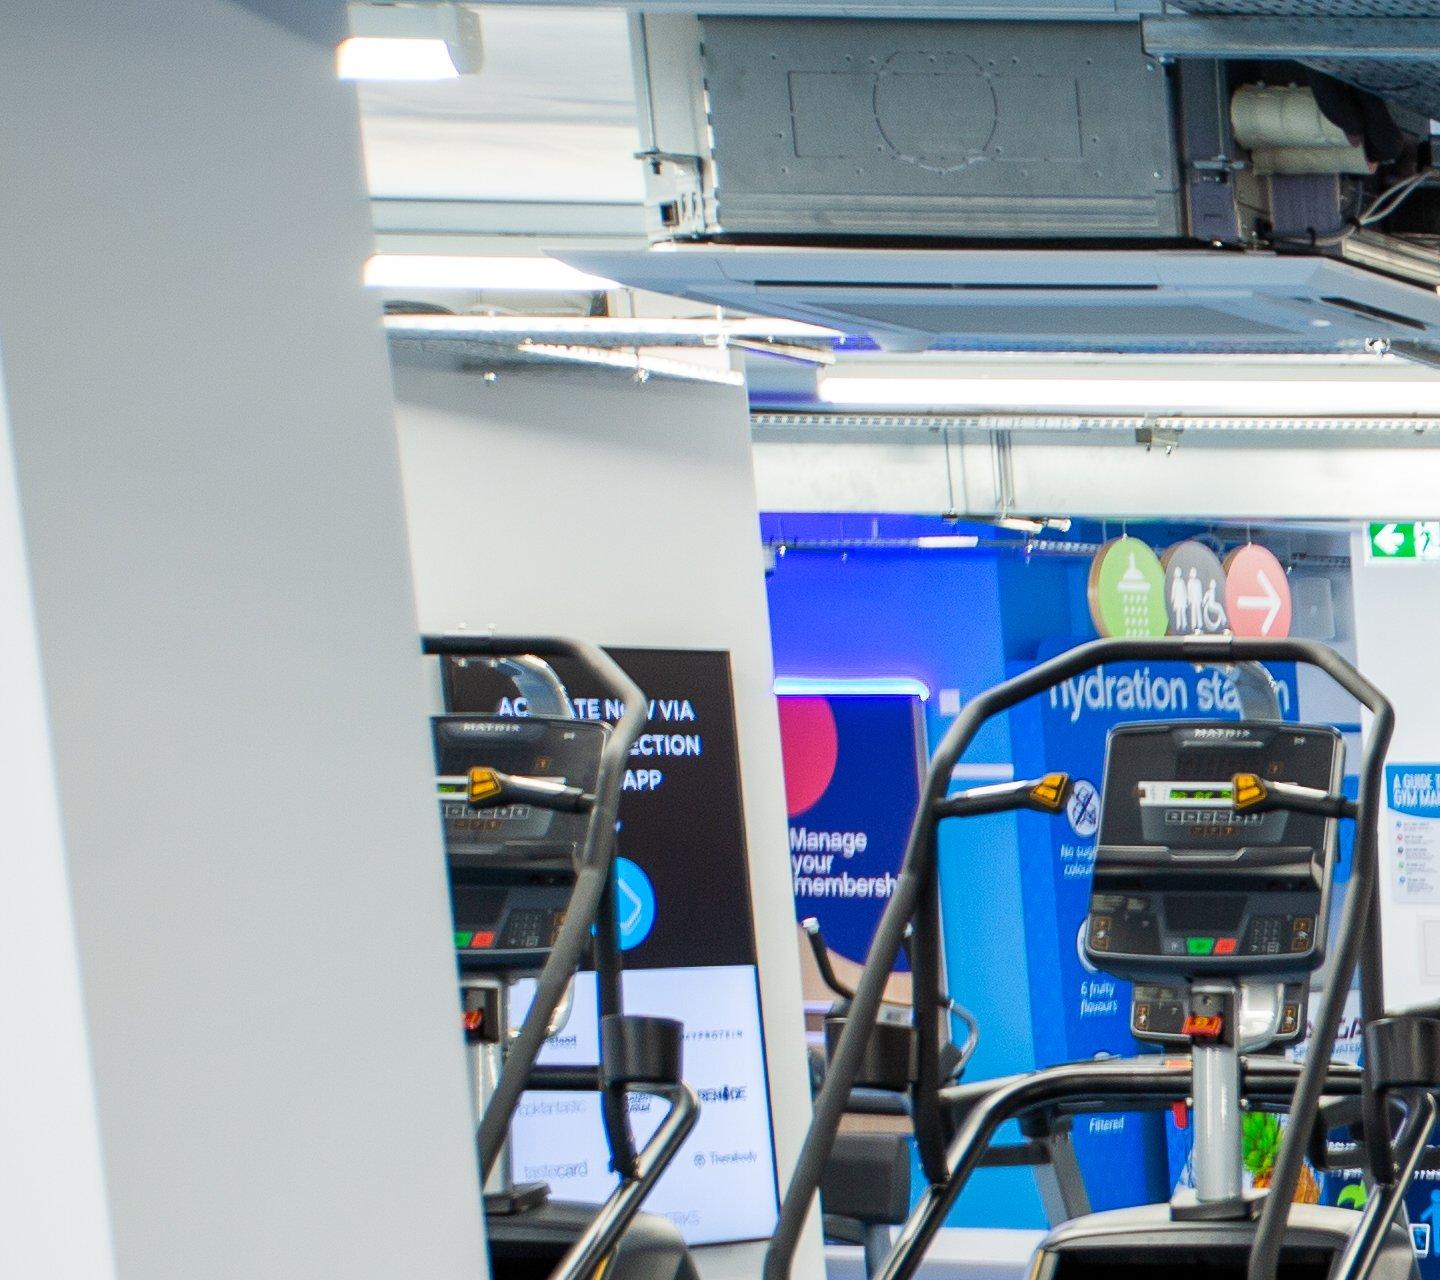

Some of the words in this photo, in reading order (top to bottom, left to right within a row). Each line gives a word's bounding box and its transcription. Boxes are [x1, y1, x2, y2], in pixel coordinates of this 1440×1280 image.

[1051, 664, 1188, 722] hydration
[1197, 666, 1291, 713] stan
[659, 699, 696, 721] VIA
[622, 769, 664, 791] APP
[790, 827, 868, 859] Manage
[792, 854, 834, 878] your
